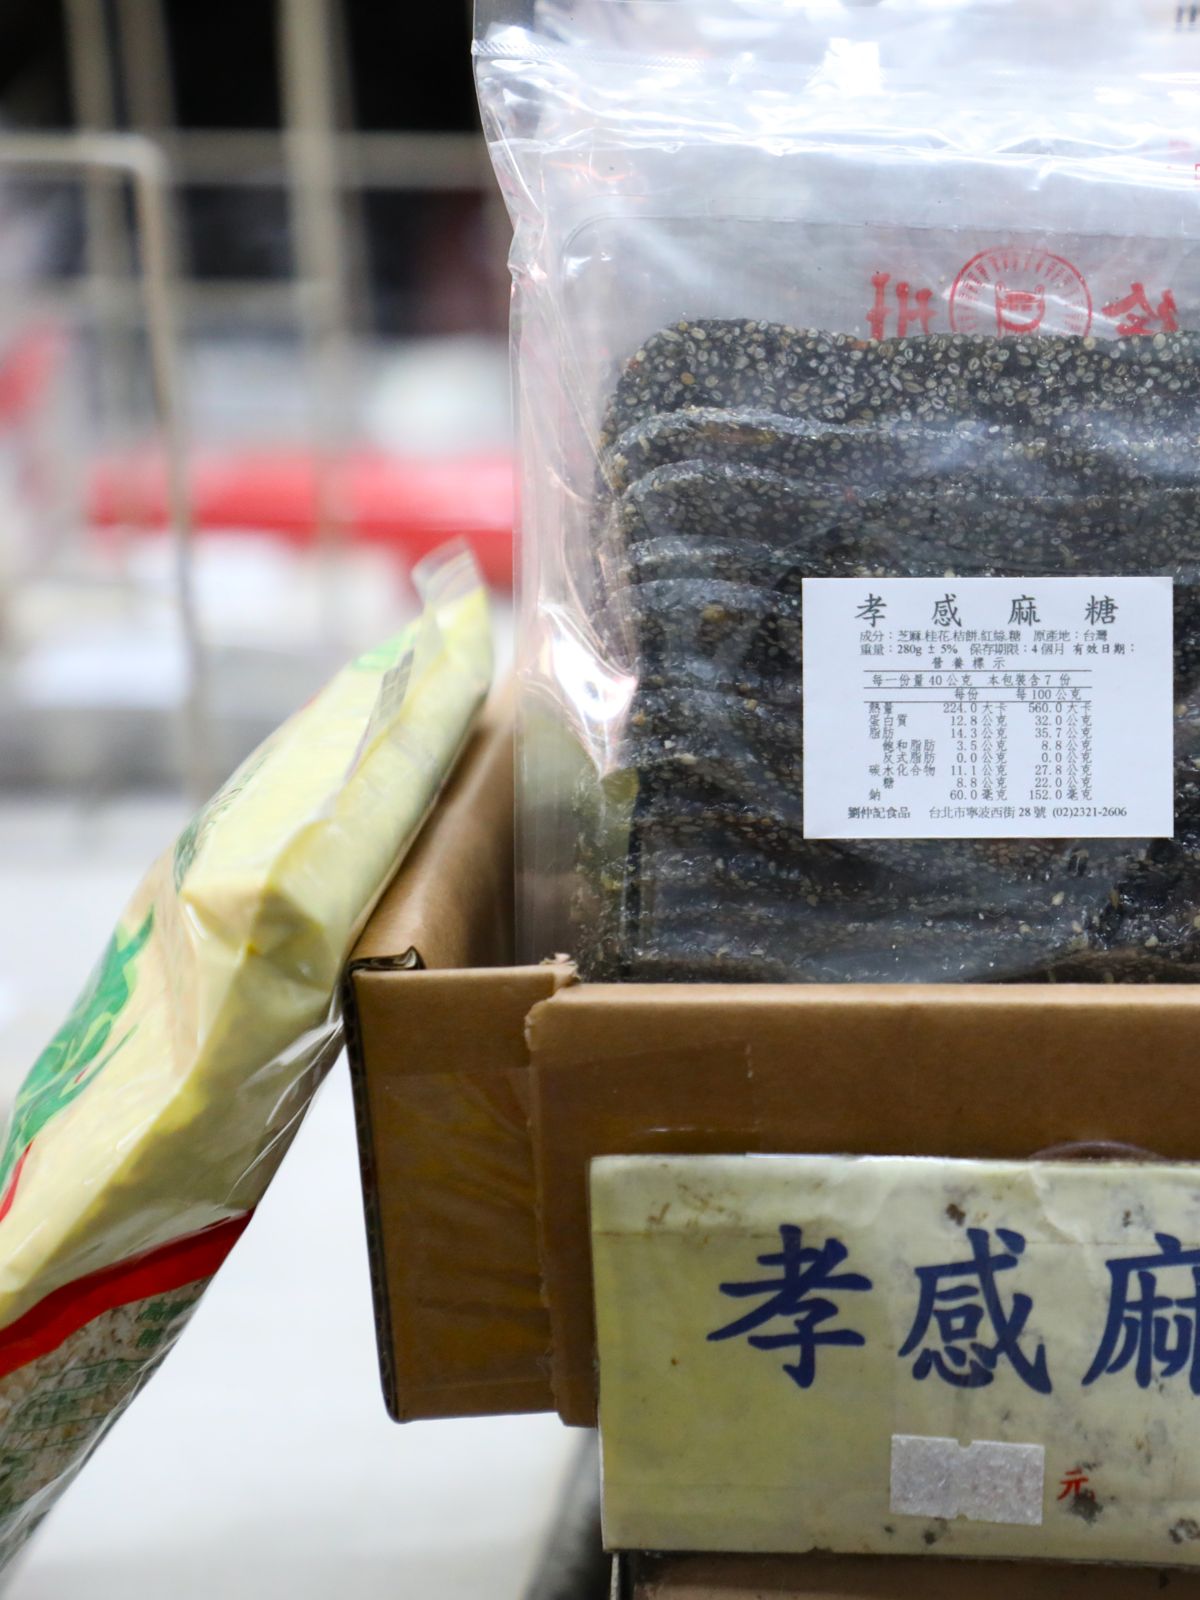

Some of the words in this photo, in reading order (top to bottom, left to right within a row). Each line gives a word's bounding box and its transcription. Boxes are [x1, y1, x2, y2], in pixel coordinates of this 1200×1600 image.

[854, 593, 1119, 628] 孝感麻糖
[1056, 1467, 1096, 1502] 元
